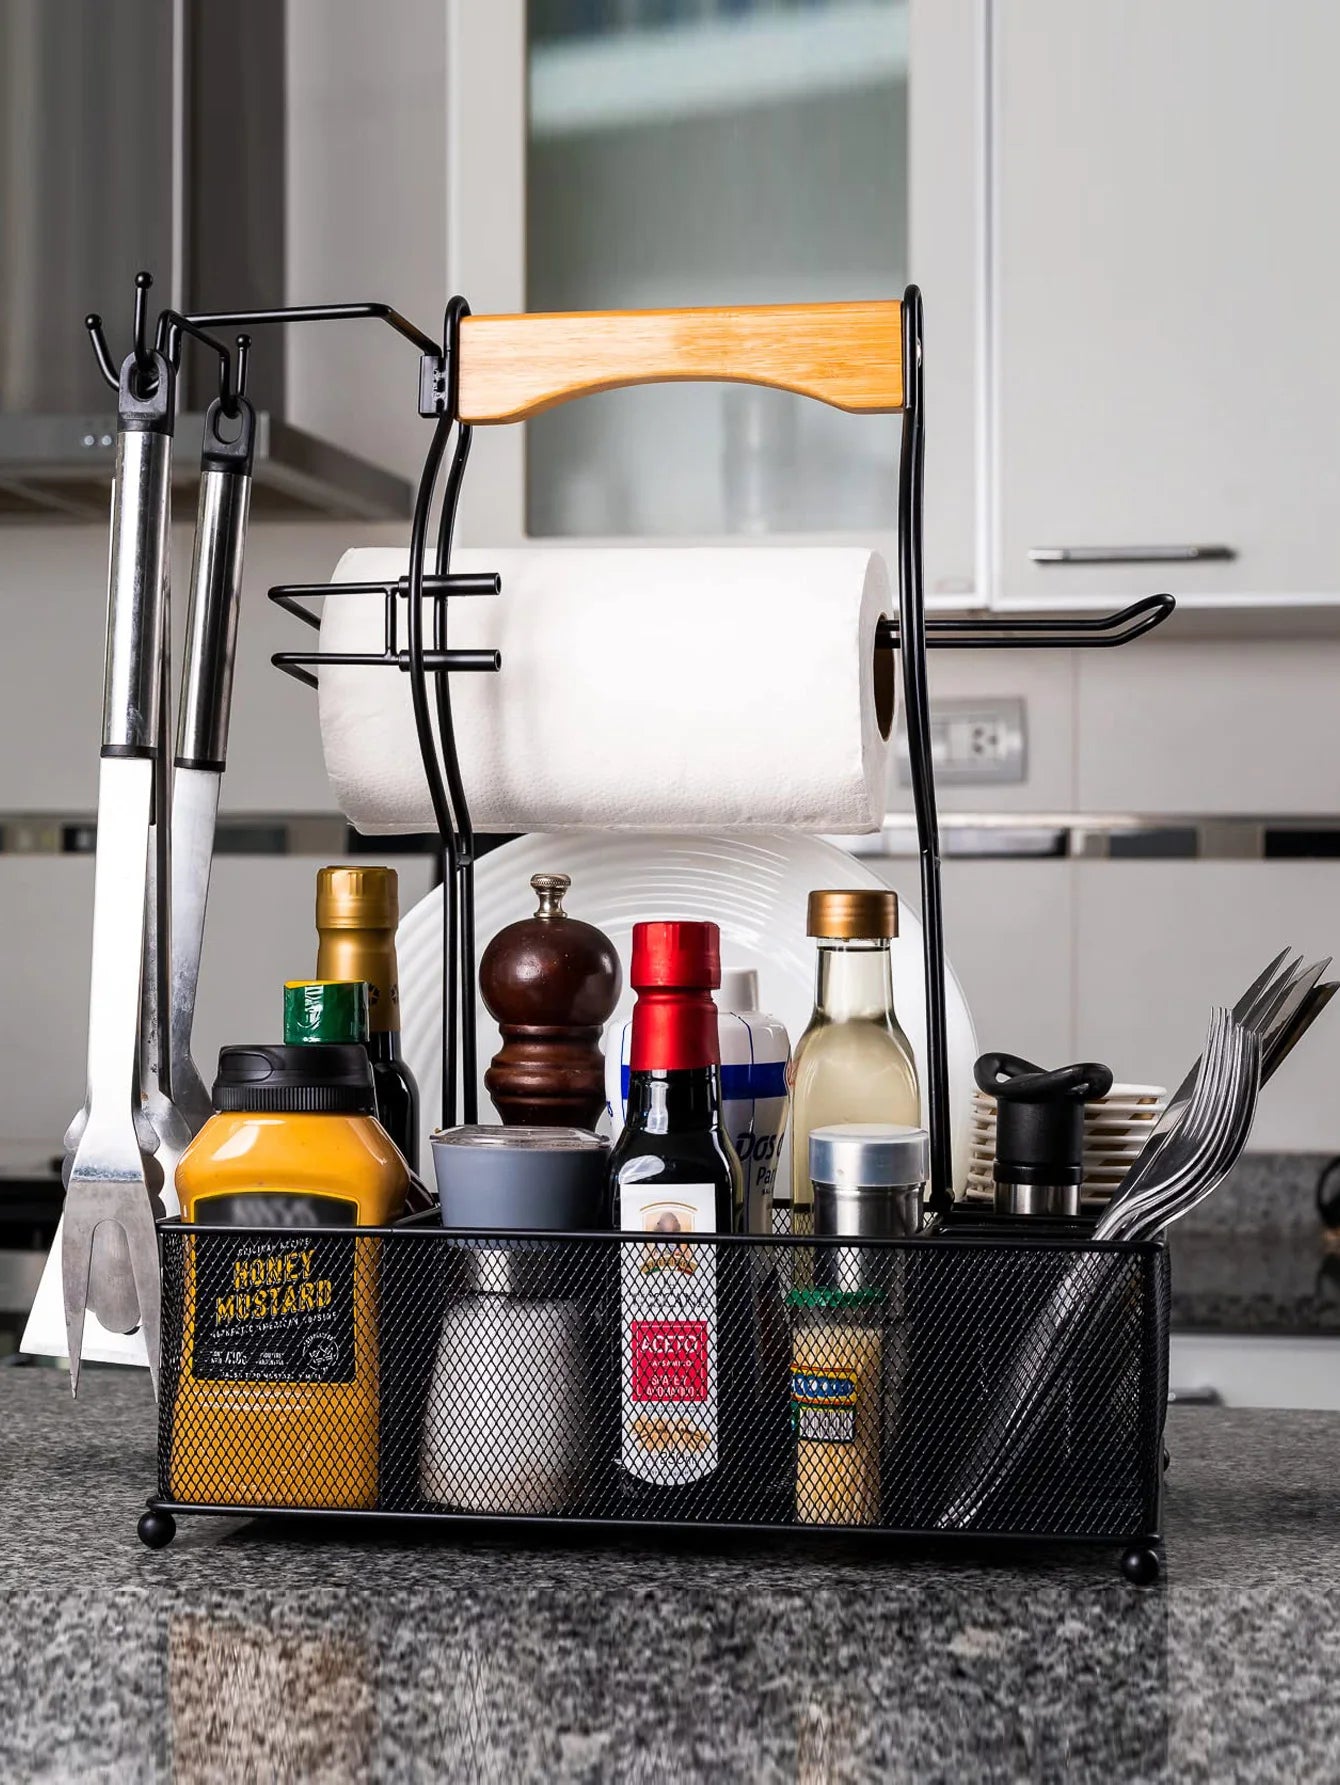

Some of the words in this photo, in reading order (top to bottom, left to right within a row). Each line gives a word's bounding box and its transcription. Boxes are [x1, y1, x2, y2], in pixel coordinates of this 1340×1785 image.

[233, 1249, 315, 1291] HONEY
[215, 1279, 332, 1326] MUSTARD
[641, 1335, 697, 1353] ACETO
